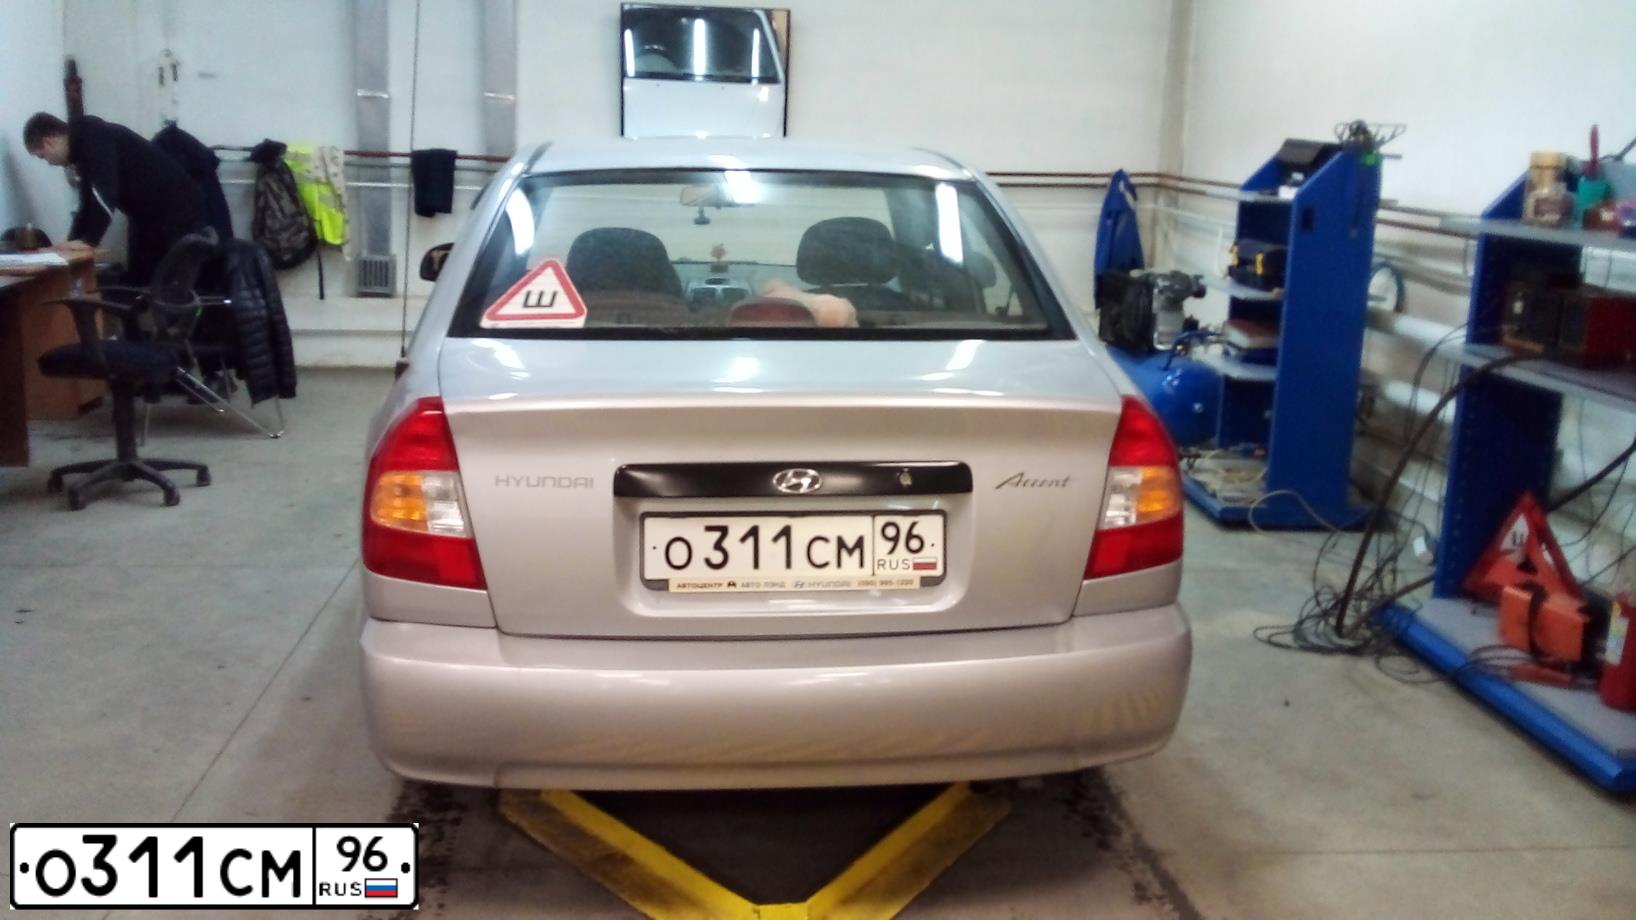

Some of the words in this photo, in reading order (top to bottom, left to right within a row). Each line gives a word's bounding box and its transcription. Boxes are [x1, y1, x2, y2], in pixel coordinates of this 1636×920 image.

[495, 475, 594, 489] HYUNDAI
[995, 471, 1071, 490] Accent
[880, 522, 925, 555] 96
[877, 558, 911, 571] RUS
